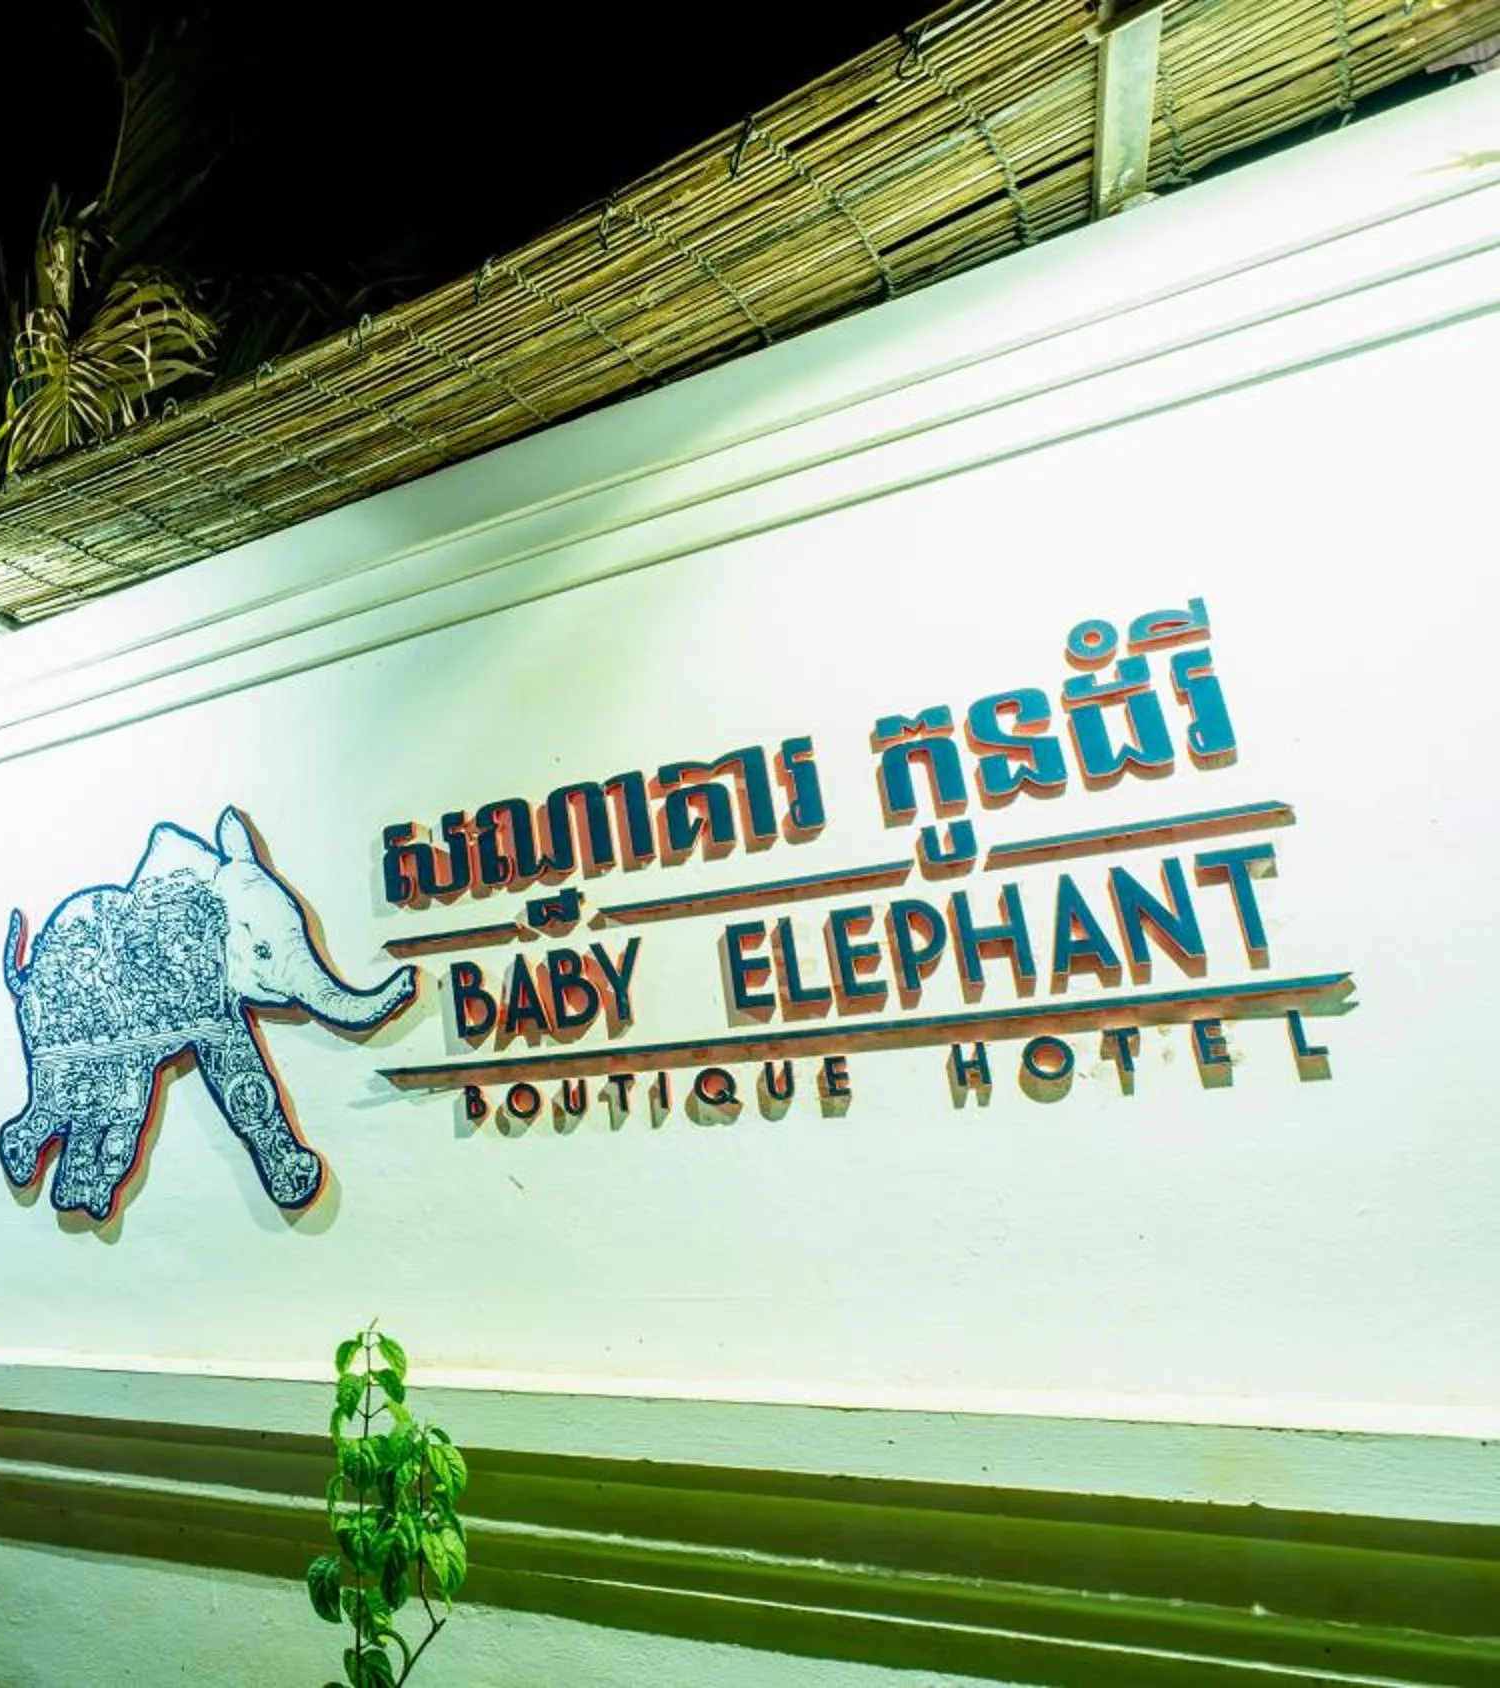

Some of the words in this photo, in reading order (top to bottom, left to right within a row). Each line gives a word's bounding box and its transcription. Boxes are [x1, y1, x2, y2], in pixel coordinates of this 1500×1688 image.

[450, 937, 642, 1038] BABY
[725, 843, 1277, 1012] ELEPHANT
[464, 1056, 852, 1122] BOUTIQUE
[952, 1010, 1329, 1090] HOTEL
